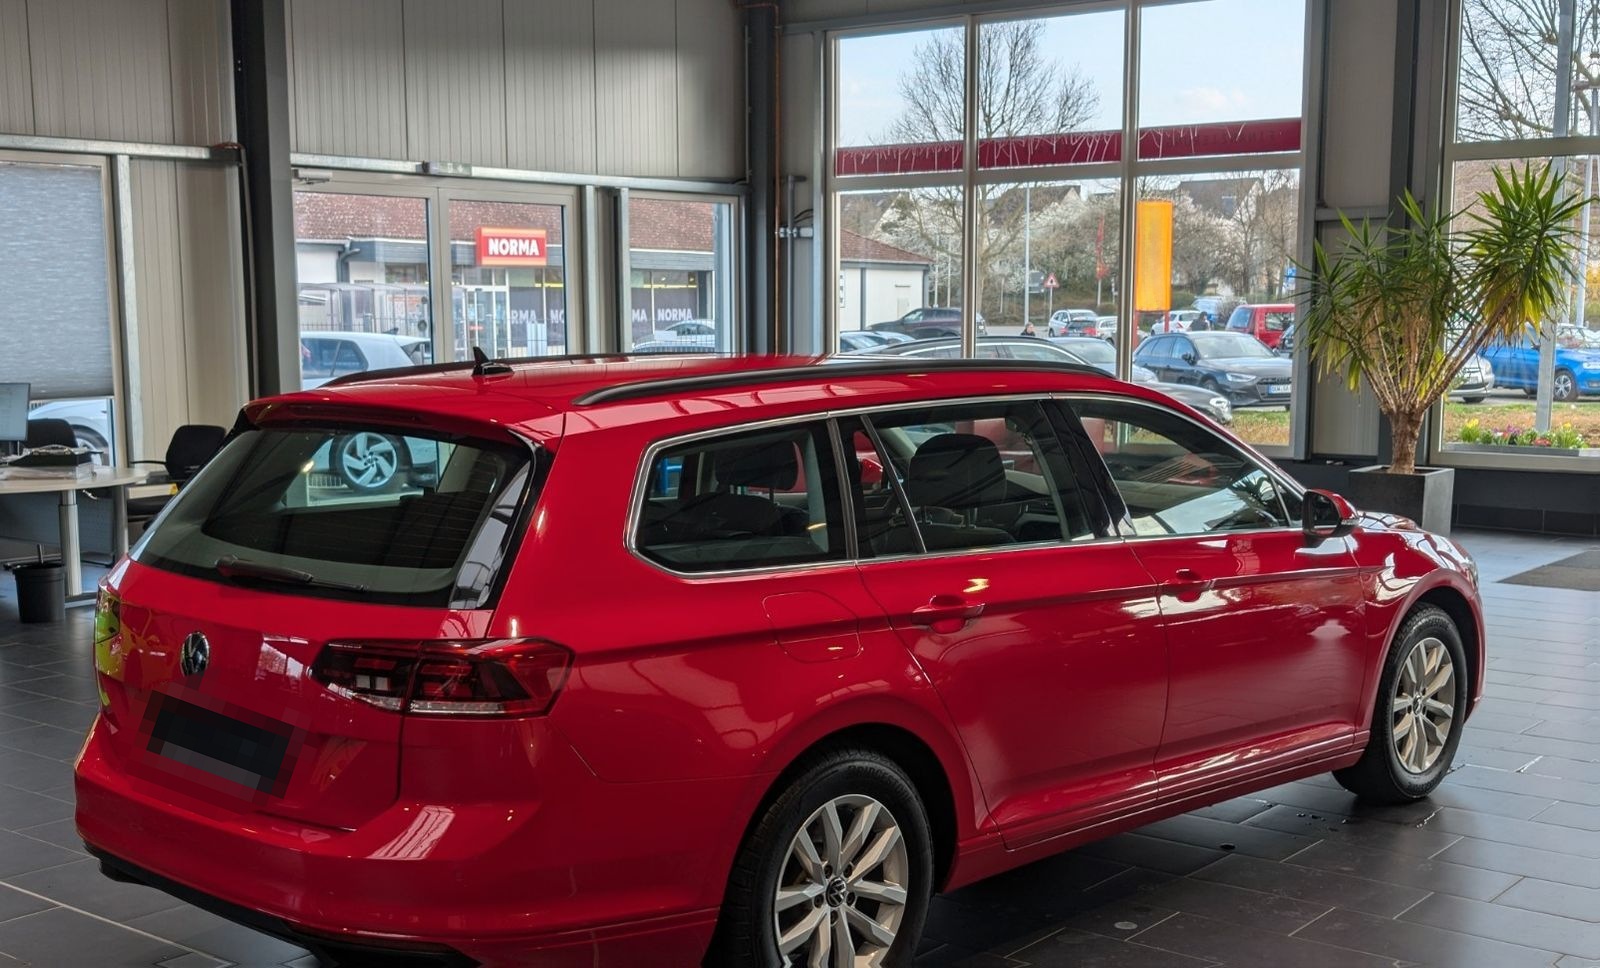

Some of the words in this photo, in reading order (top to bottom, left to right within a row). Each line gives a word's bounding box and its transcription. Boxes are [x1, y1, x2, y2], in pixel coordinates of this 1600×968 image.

[488, 238, 539, 256] NORMA
[511, 309, 537, 324] RMA
[657, 308, 694, 321] NORMA
